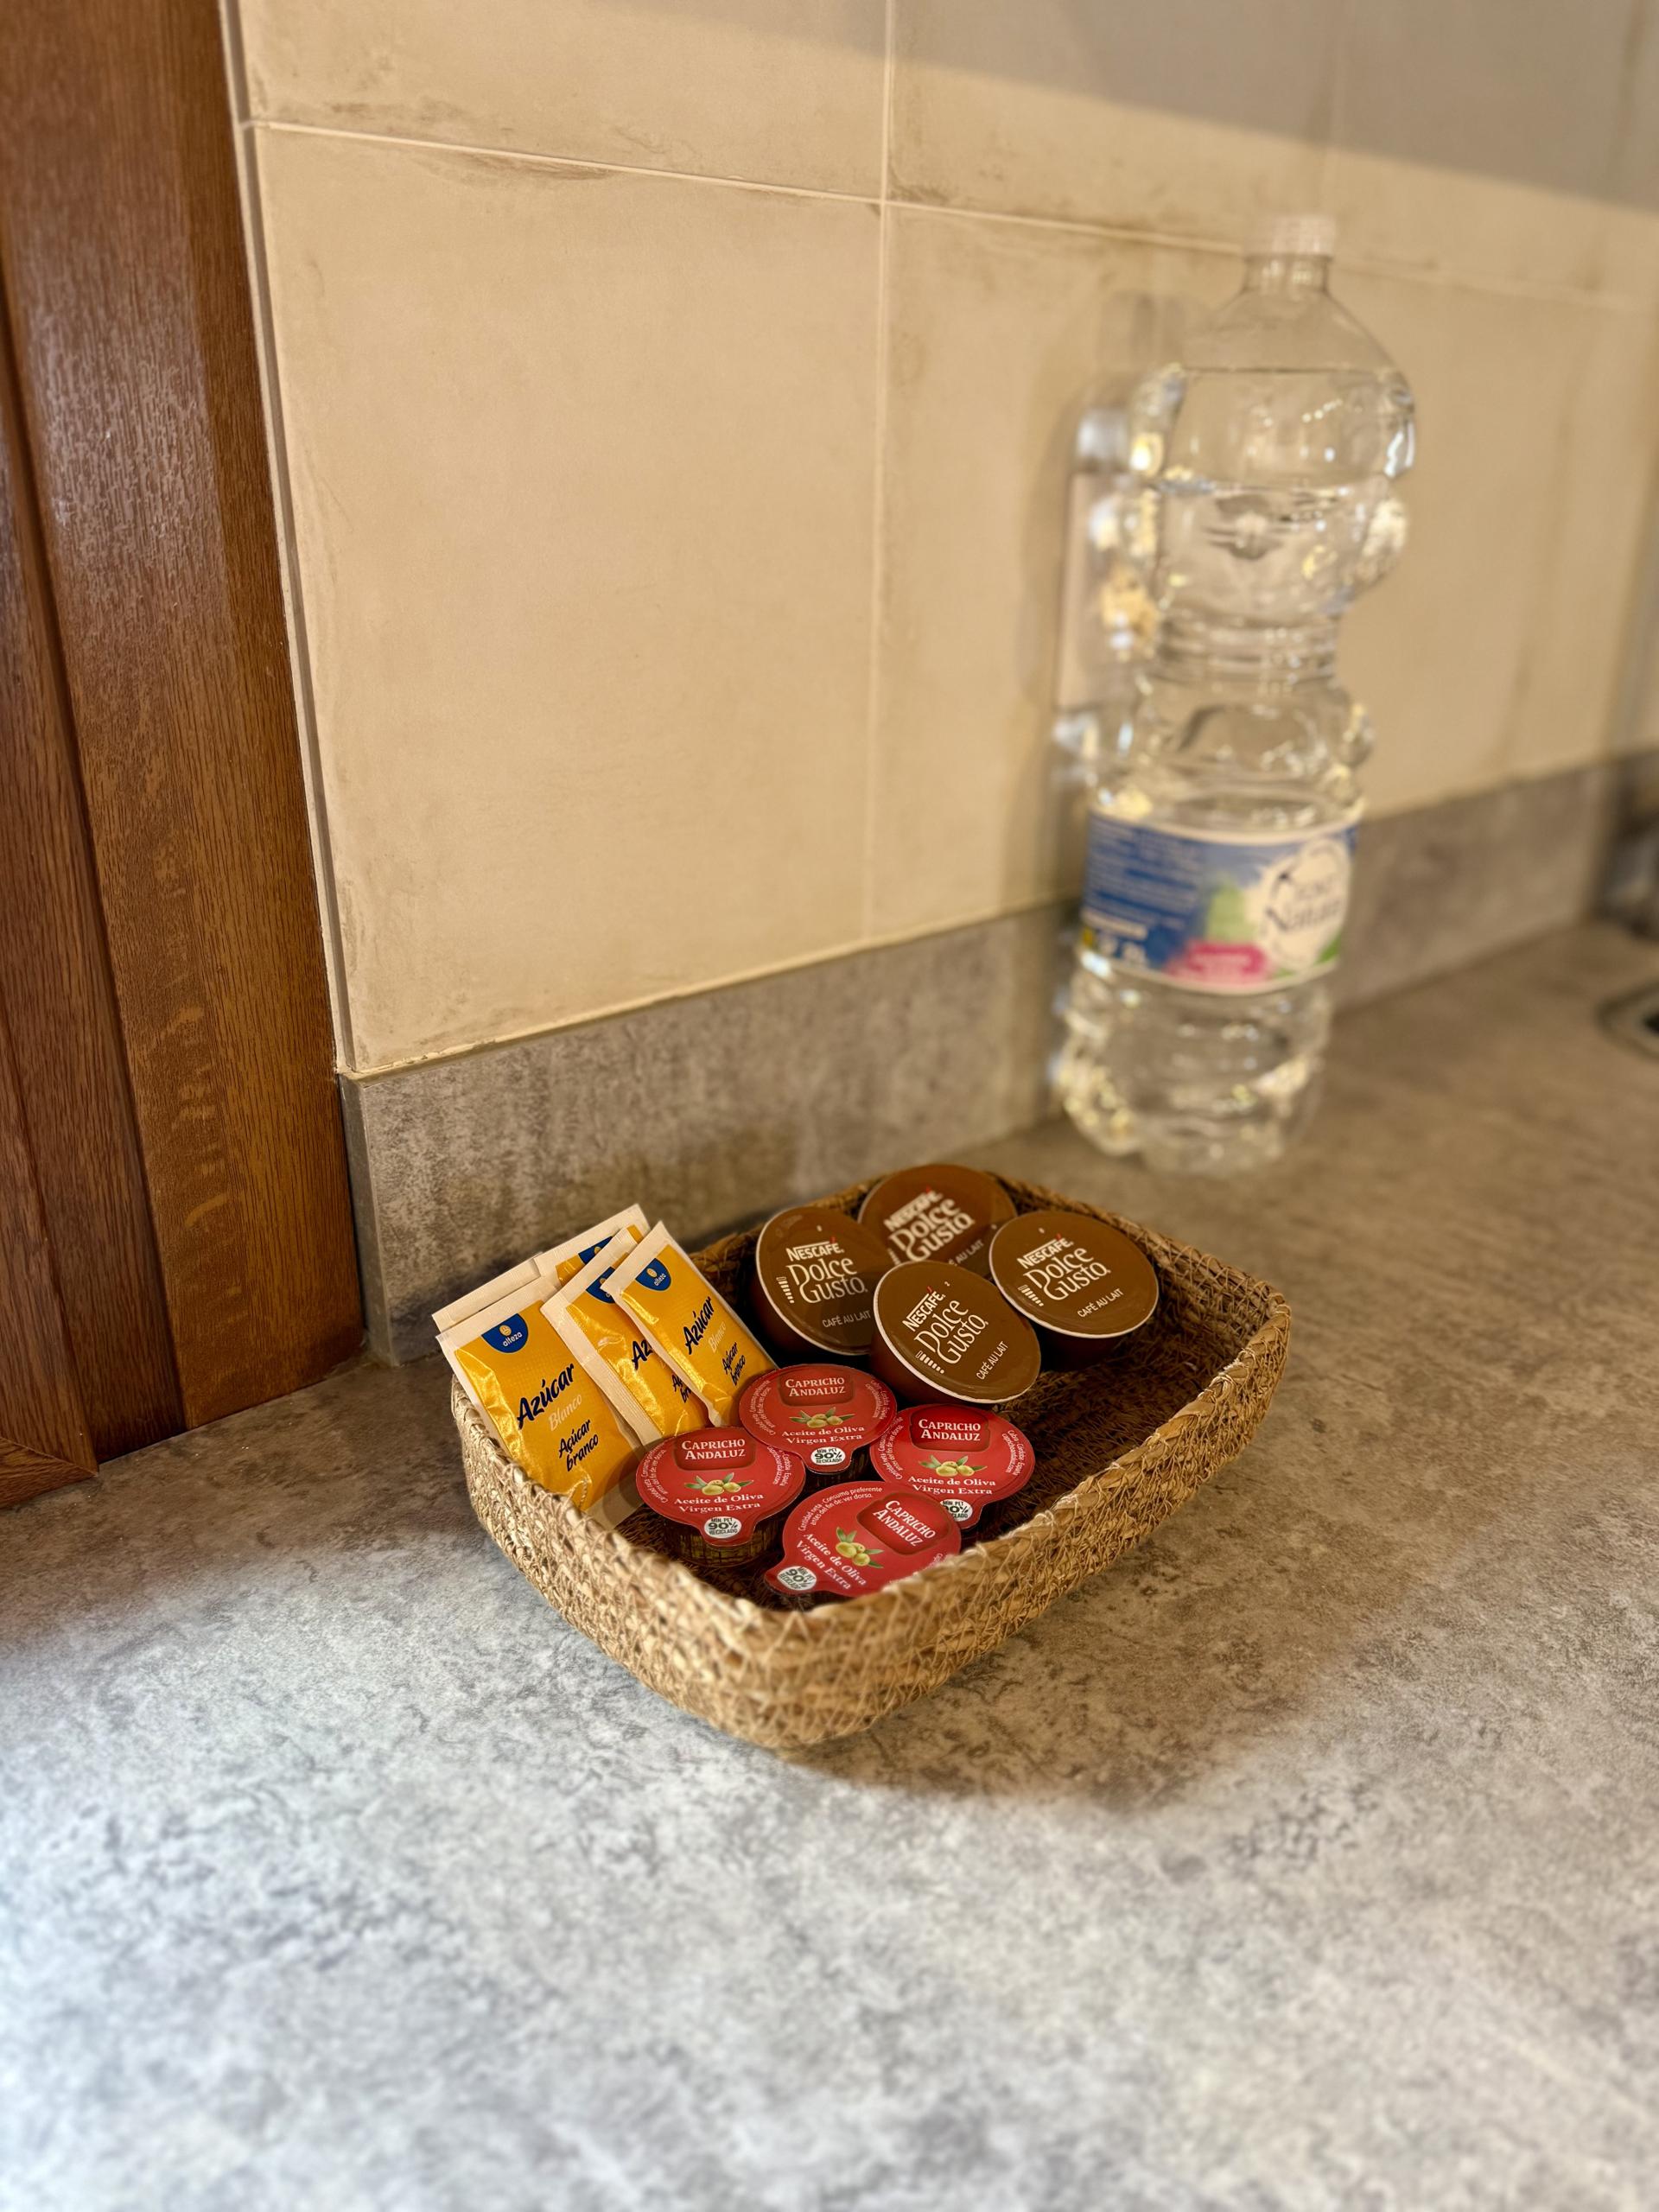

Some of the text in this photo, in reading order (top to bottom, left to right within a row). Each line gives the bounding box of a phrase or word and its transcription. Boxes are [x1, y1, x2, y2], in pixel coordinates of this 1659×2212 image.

[888, 1198, 960, 1251] Dolce
[906, 1212, 975, 1262] Gusto
[786, 1258, 857, 1286] Dolce
[1023, 1248, 1094, 1288] Dolce
[1044, 1262, 1109, 1300] Gusto
[799, 1276, 867, 1303] Gusto
[1077, 1288, 1124, 1318] CAFÉ AU LAIT
[683, 1296, 715, 1355] Azúcar
[823, 1310, 871, 1328] CAFÉ AU LAIT
[914, 1300, 969, 1353] Dolce
[503, 1332, 523, 1347] alteza
[708, 1321, 727, 1353] Blanco
[938, 1314, 988, 1363] Gusto
[730, 1355, 746, 1386] branco
[976, 1341, 1008, 1380] CAFÉ AU LAIT
[517, 1363, 575, 1430] Azúcar
[785, 1377, 845, 1389] CAPRICHO
[789, 1386, 846, 1397] ANDALUZ
[548, 1395, 582, 1431] Blanco
[918, 1419, 981, 1432] CAPRICHO
[559, 1419, 591, 1459] Açúcar
[682, 1439, 746, 1451] CAPRICHO
[785, 1433, 862, 1446] Virgen Extra
[920, 1428, 981, 1441] ANDALUZ
[567, 1434, 599, 1471] branco
[685, 1448, 746, 1460] ANDALUZ
[908, 1475, 944, 1485] Aceite
[912, 1484, 955, 1495] Virgen
[679, 1502, 761, 1514] Virgen Extra
[730, 1493, 764, 1502] Oliva
[709, 1521, 738, 1529] 90%
[873, 1509, 923, 1547] ANDALUZ
[885, 1500, 937, 1539] CAPRICHO
[796, 1541, 851, 1590] Virgen Extra
[803, 1533, 867, 1586] Aceite de Oliva
[785, 1568, 812, 1587] 90%
